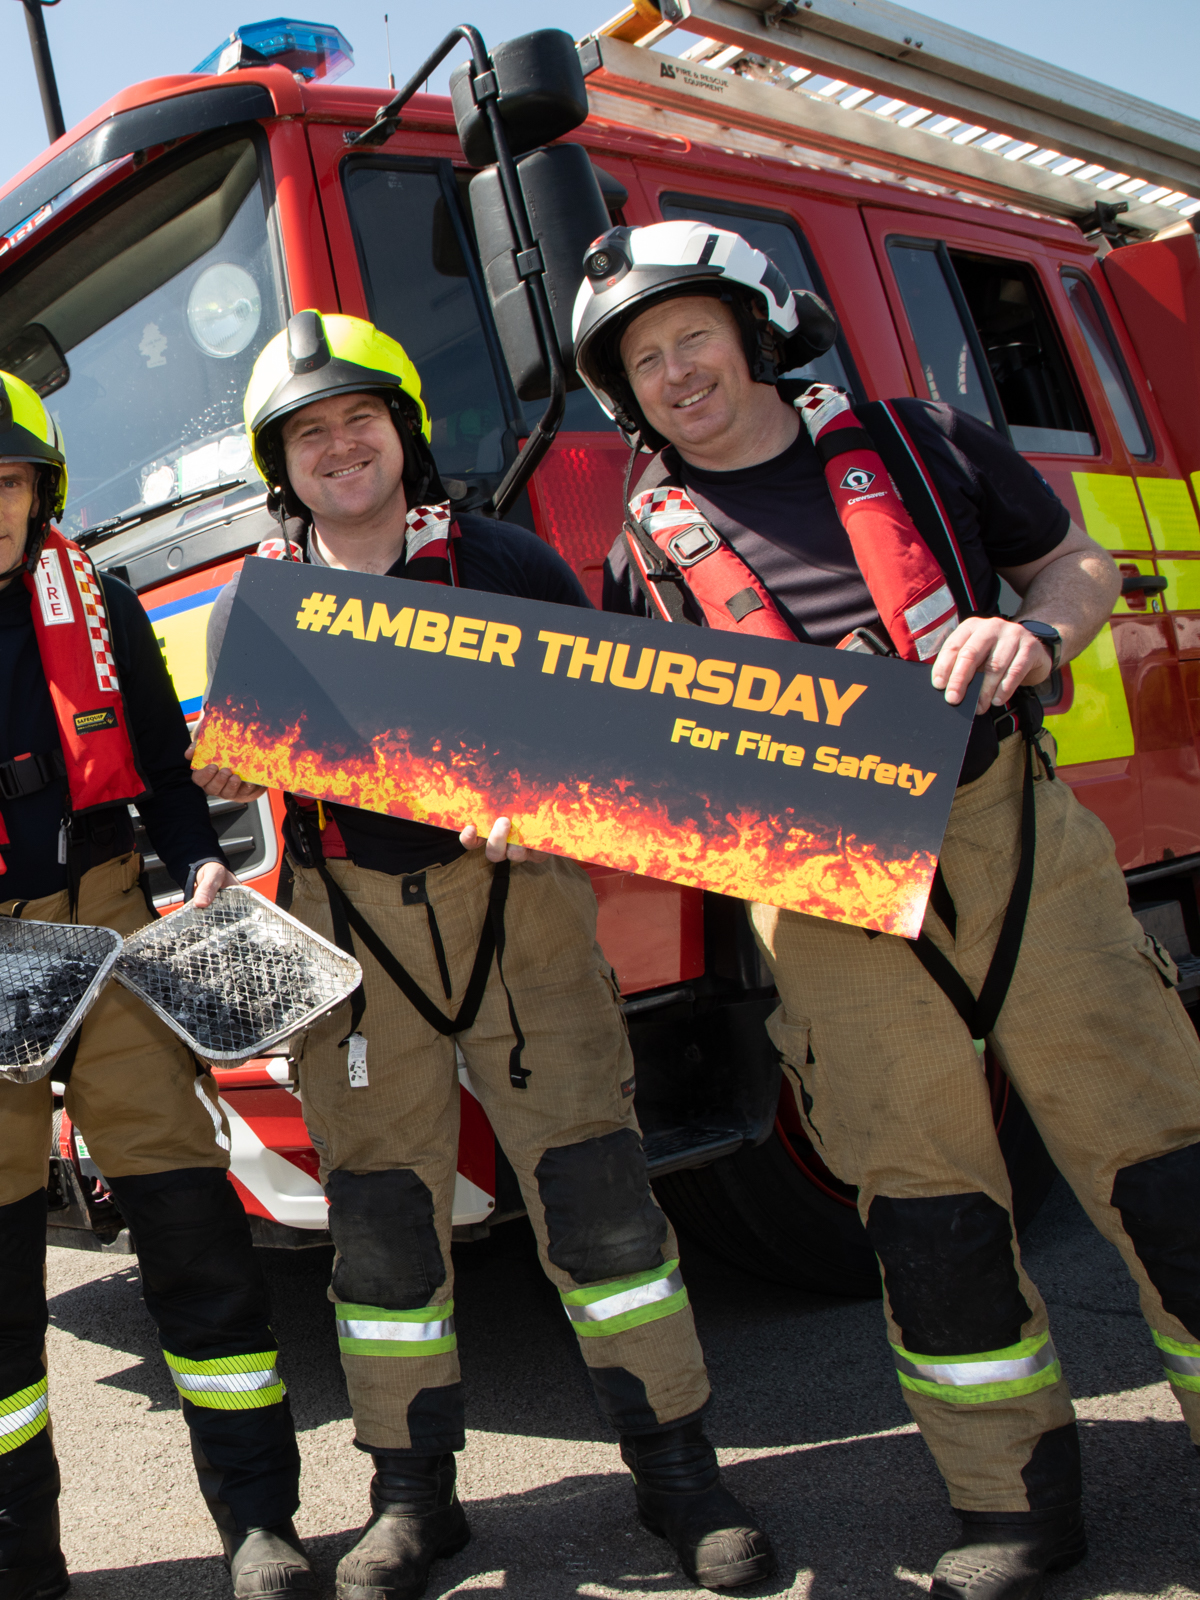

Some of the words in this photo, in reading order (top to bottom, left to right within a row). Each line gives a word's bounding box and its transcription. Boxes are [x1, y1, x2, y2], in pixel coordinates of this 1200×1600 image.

[676, 67, 692, 77] FIRE
[700, 74, 729, 87] RESCUE
[684, 77, 724, 93] EQUIPMENT
[847, 491, 885, 505] Crewsaver
[40, 557, 64, 616] FIRE
[295, 591, 523, 668] #AMBER
[537, 629, 869, 727] THURSDAY
[670, 717, 730, 751] For
[735, 729, 806, 767] Fire
[812, 745, 938, 797] Safety
